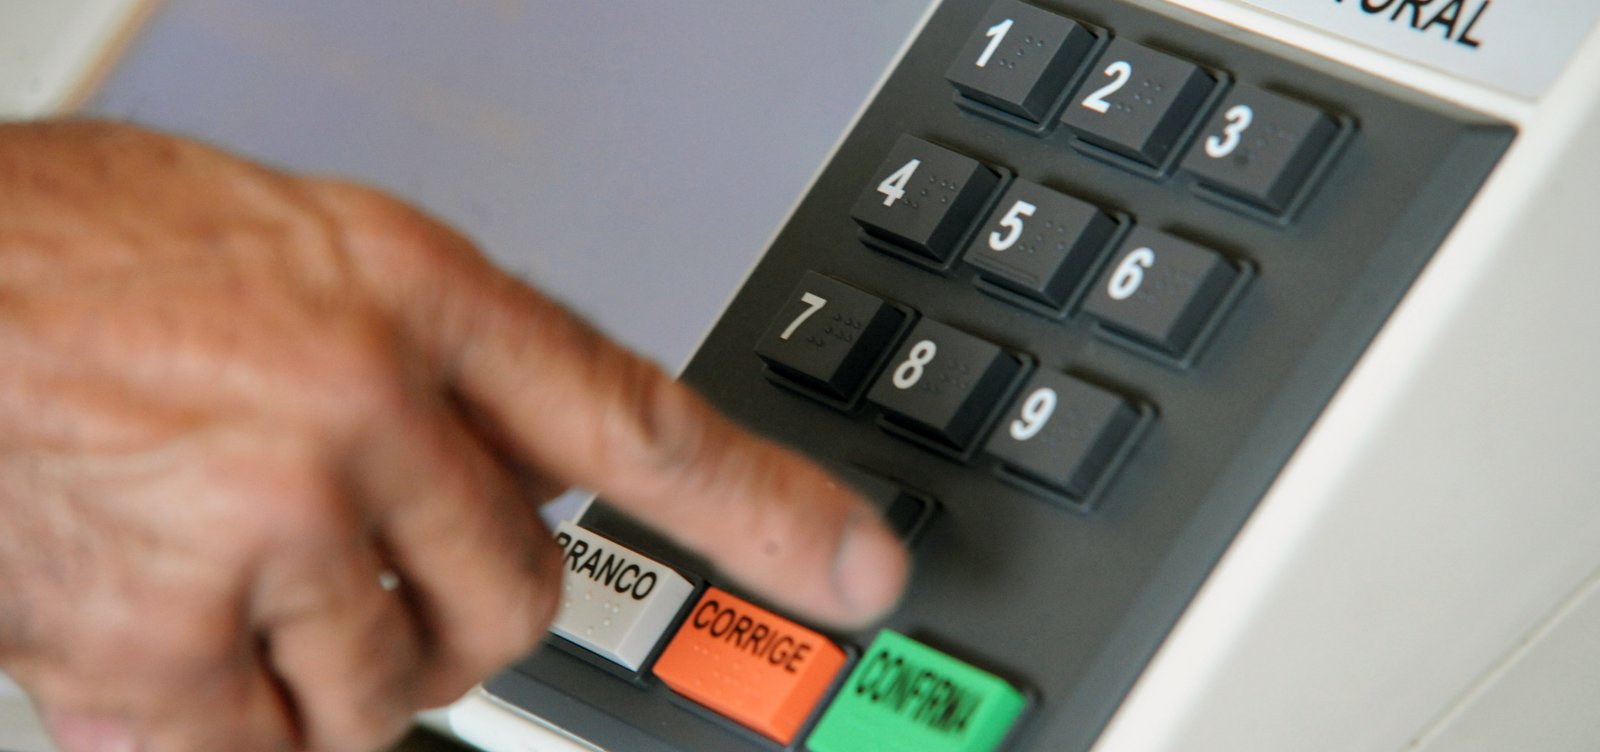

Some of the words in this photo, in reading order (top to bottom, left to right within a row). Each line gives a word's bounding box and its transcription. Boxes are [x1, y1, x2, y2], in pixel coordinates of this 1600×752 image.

[976, 18, 1014, 67] 1
[1335, 0, 1480, 47] RAL
[1081, 60, 1132, 114] 2
[1205, 105, 1253, 158] 3
[877, 158, 920, 206] 4
[989, 200, 1037, 251] 5
[1107, 246, 1155, 300] 6
[781, 292, 827, 340] 7
[893, 340, 937, 390] 8
[1009, 387, 1058, 441] 9
[694, 599, 812, 675] CORRIGE
